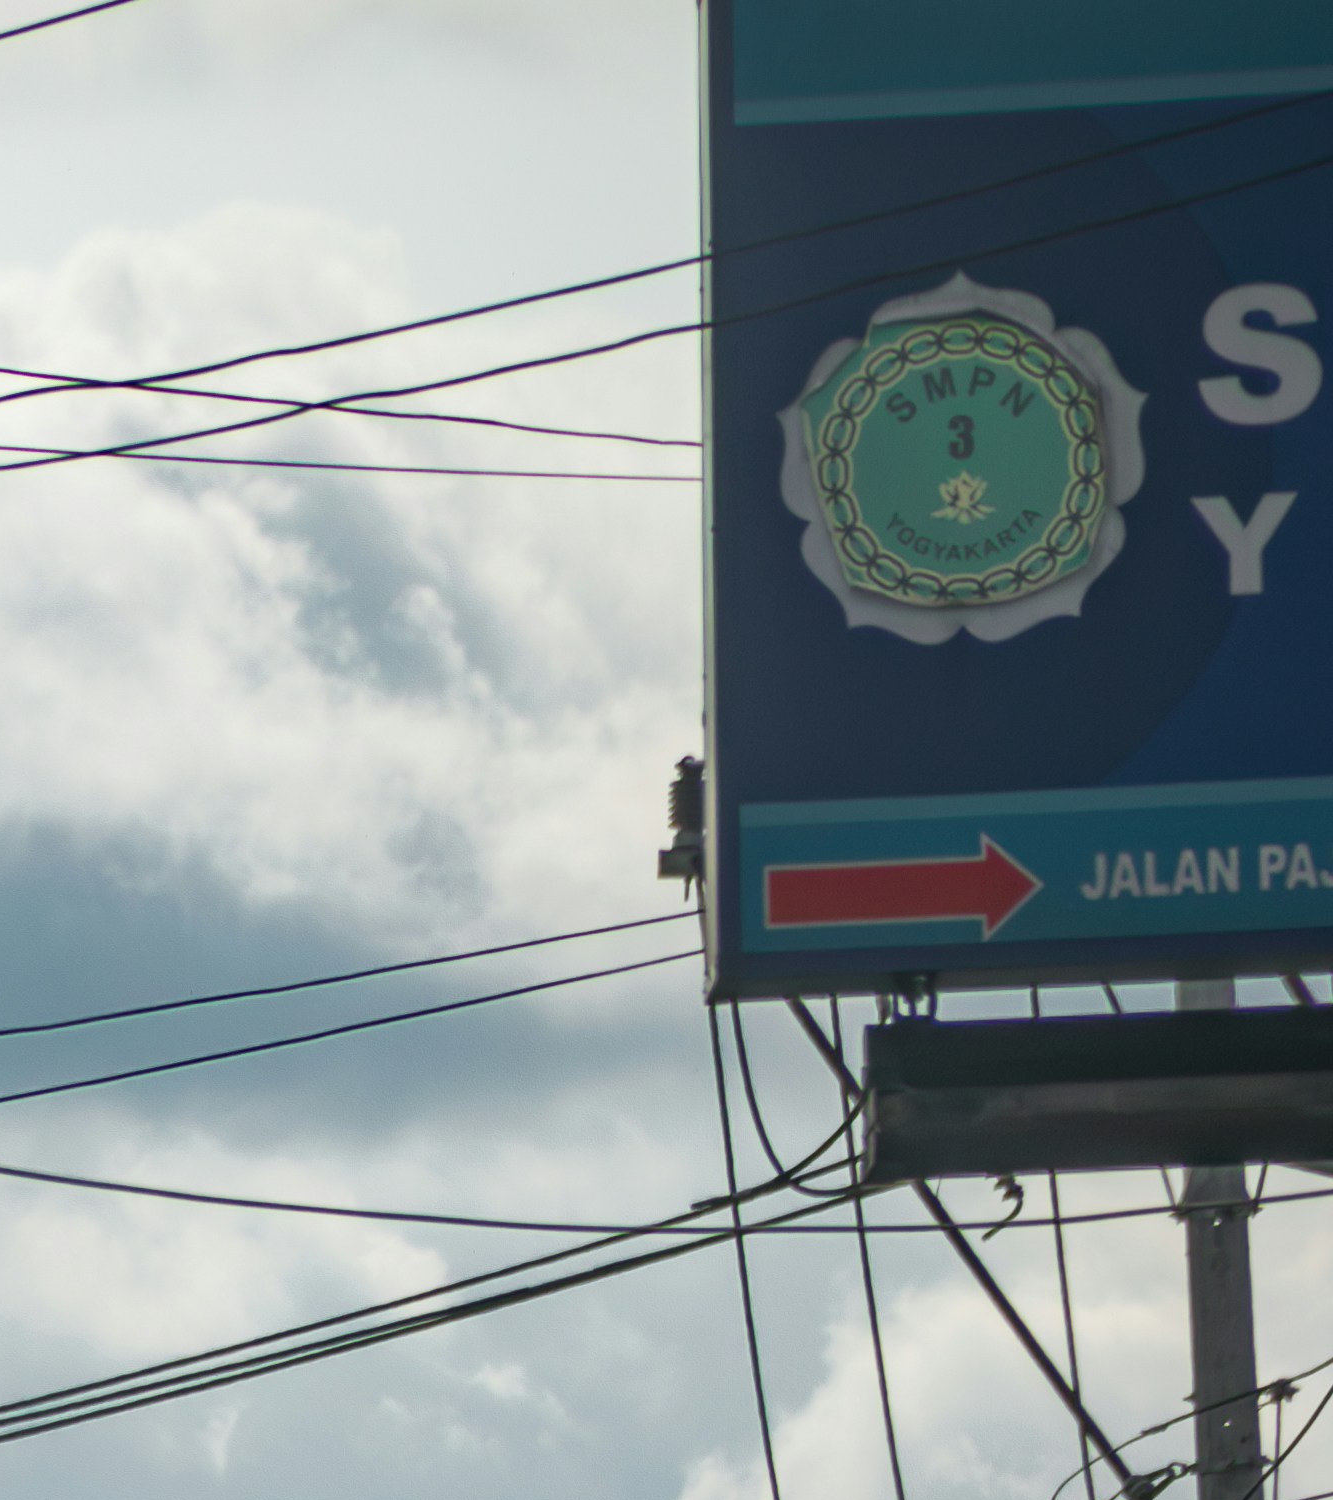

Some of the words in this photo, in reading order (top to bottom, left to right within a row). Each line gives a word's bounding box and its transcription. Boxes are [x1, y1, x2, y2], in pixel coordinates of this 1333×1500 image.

[886, 366, 1035, 423] SMPN
[948, 415, 975, 460] 3
[886, 509, 1043, 562] YOGYAKARTA
[1081, 846, 1240, 900] JALAN
